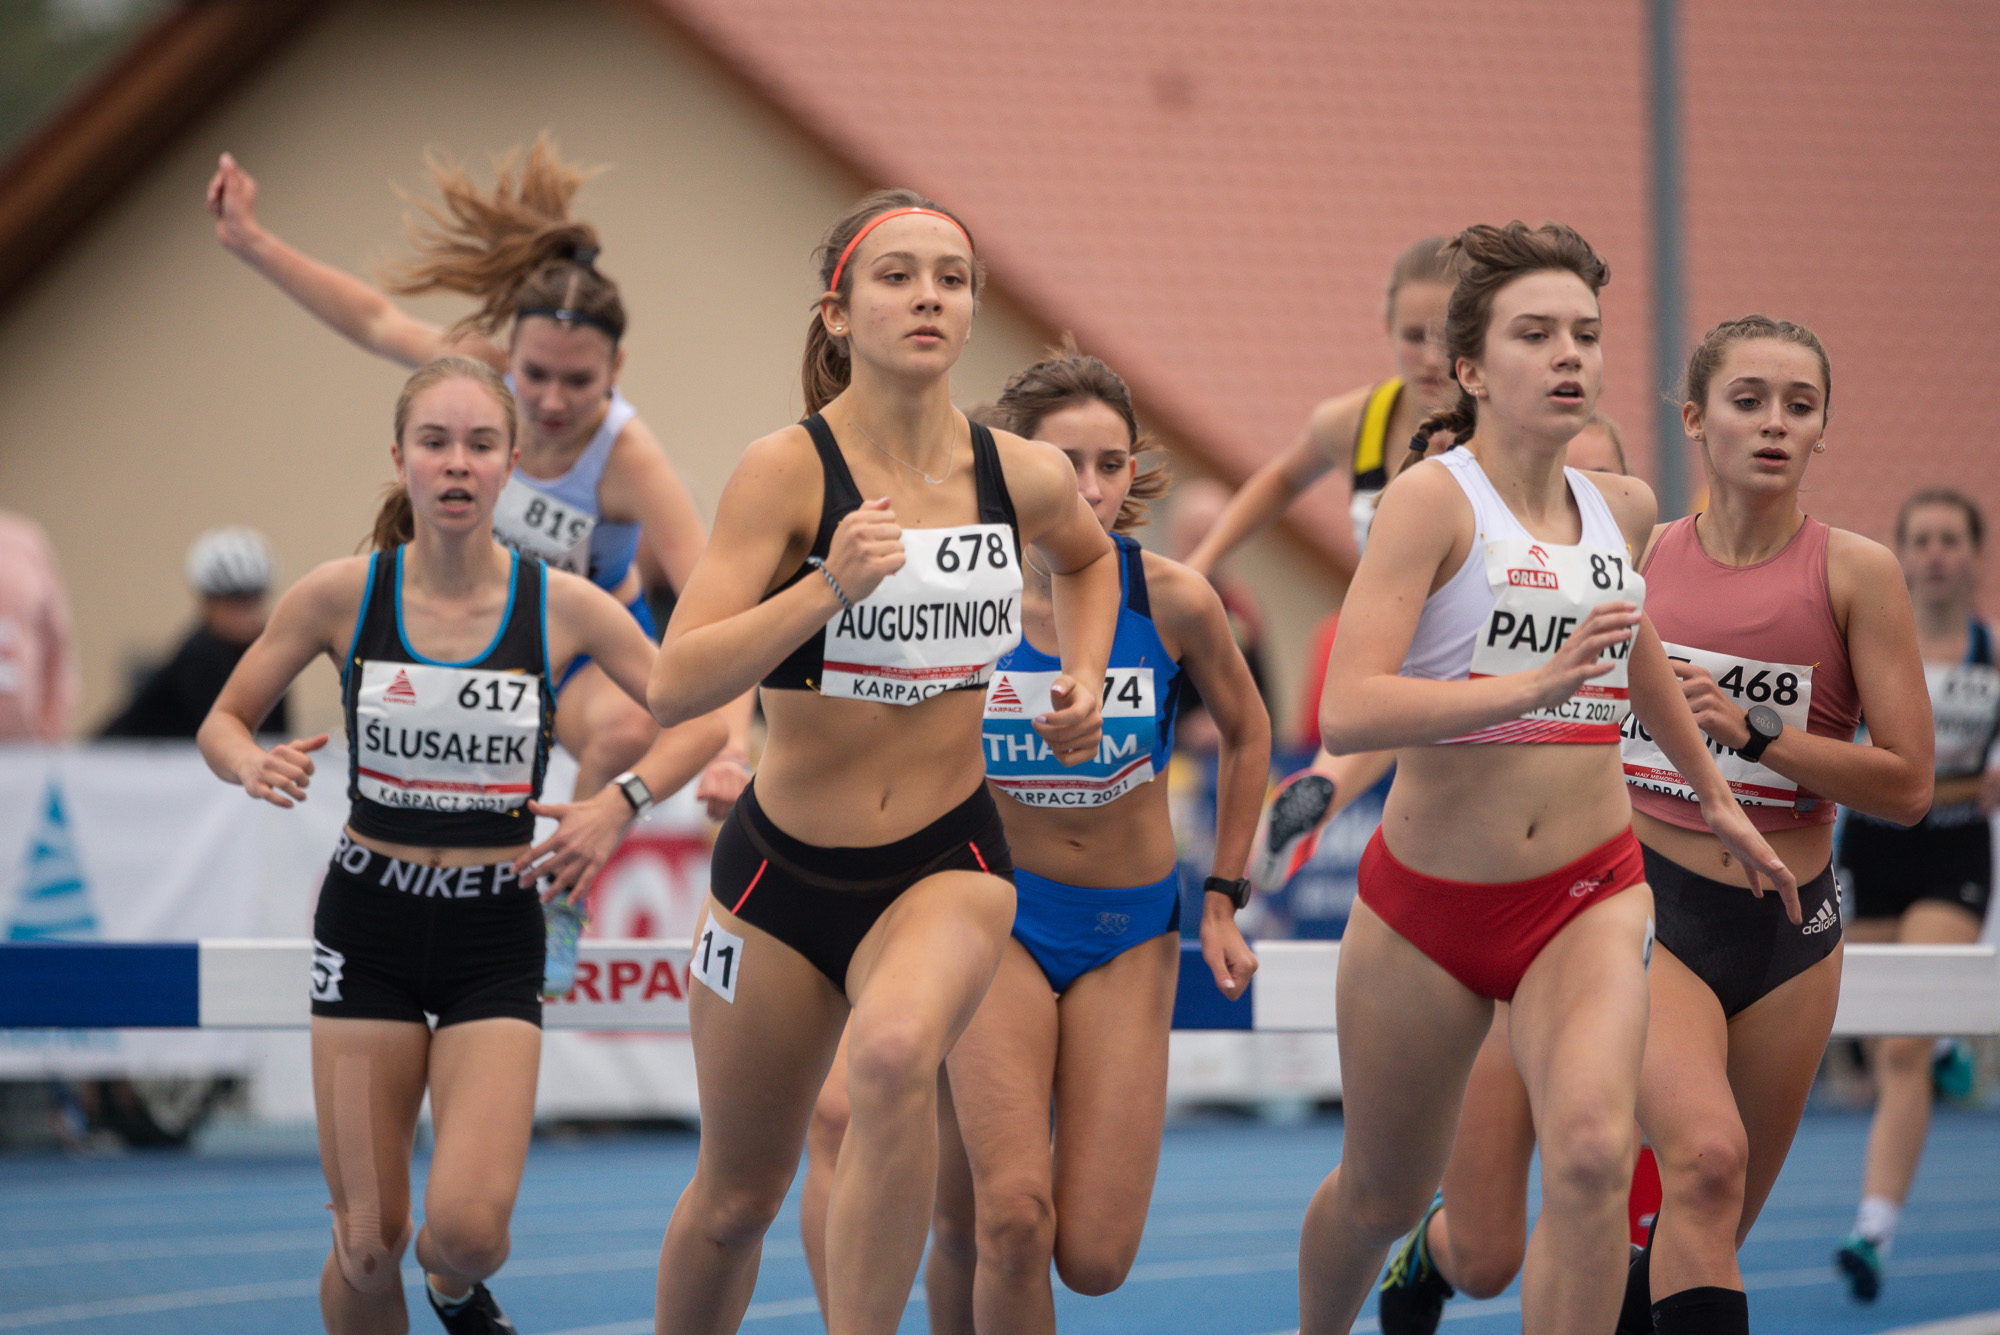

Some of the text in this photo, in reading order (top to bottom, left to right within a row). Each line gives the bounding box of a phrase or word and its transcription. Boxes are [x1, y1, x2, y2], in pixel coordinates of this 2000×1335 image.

[936, 533, 1008, 572] 678
[1511, 572, 1556, 588] ORLEN
[836, 597, 1014, 642] AUGUSTINIOK
[458, 678, 526, 711] 617
[1718, 665, 1798, 706] 468
[1586, 702, 1616, 721] 2021
[366, 718, 527, 764] ŚLUSAŁEK
[1005, 789, 1086, 805] ARPACZ
[1092, 780, 1128, 804] 2021
[379, 858, 485, 898] NIKE
[1802, 913, 1837, 935] adidas
[702, 930, 734, 990] 11
